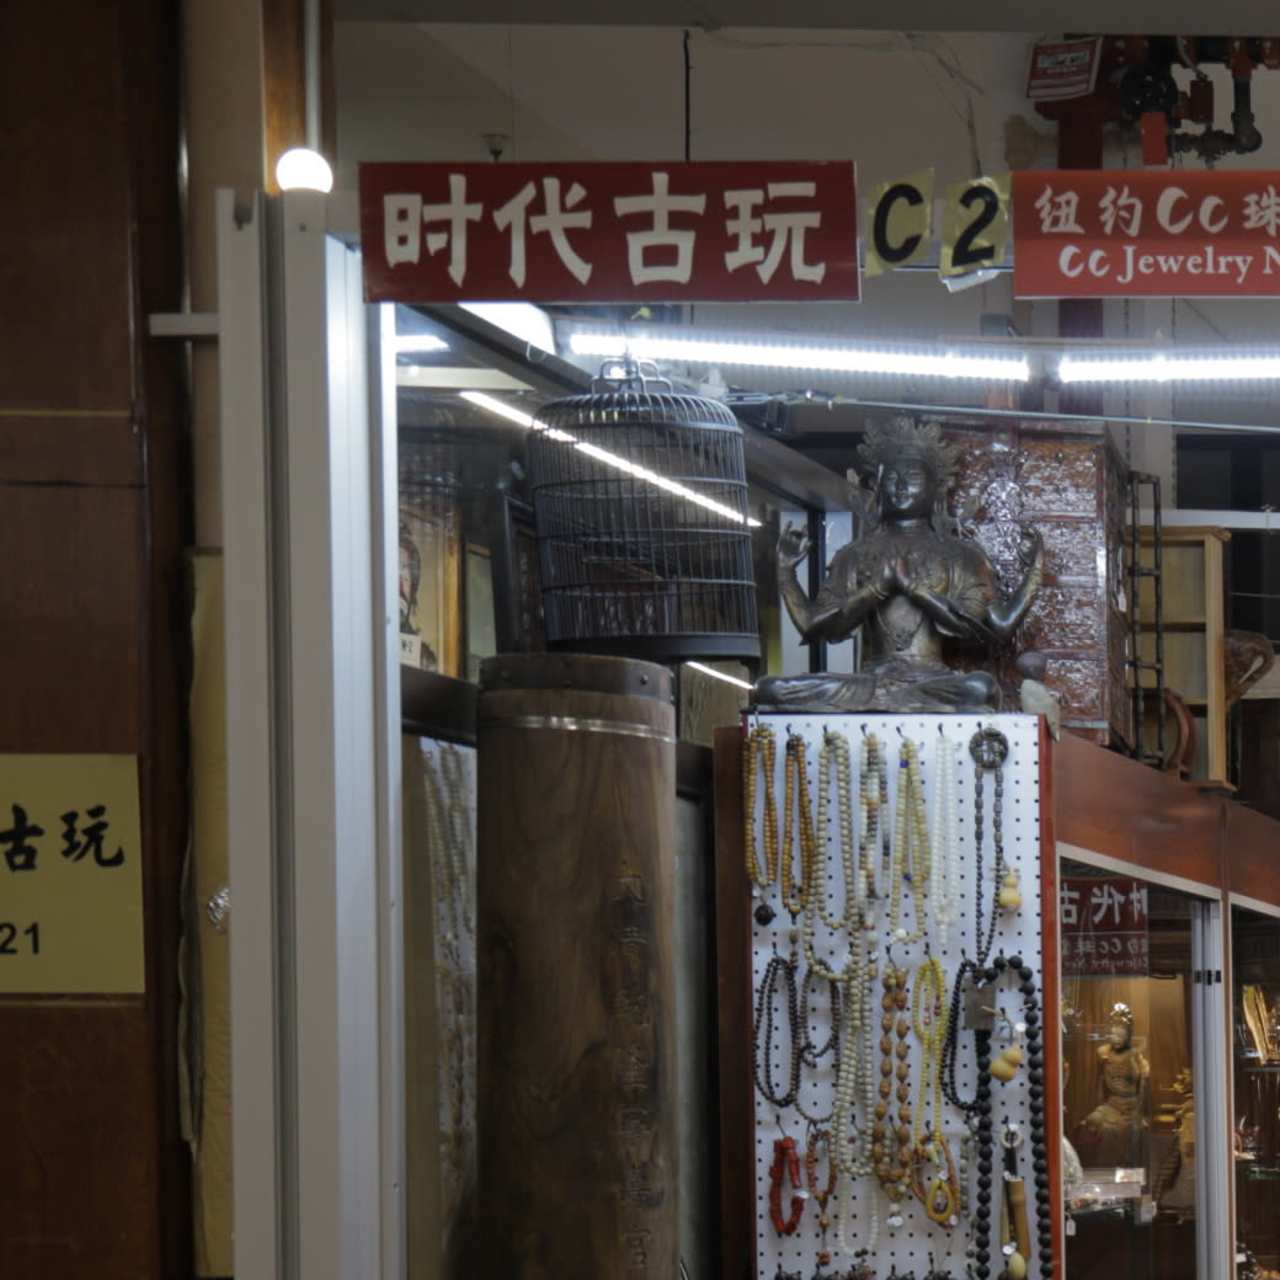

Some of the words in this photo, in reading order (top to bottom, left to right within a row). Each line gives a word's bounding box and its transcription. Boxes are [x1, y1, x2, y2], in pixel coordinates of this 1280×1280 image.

[383, 172, 826, 289] 时代古玩
[1116, 245, 1255, 283] Jewelry
[0, 803, 125, 873] 古玩
